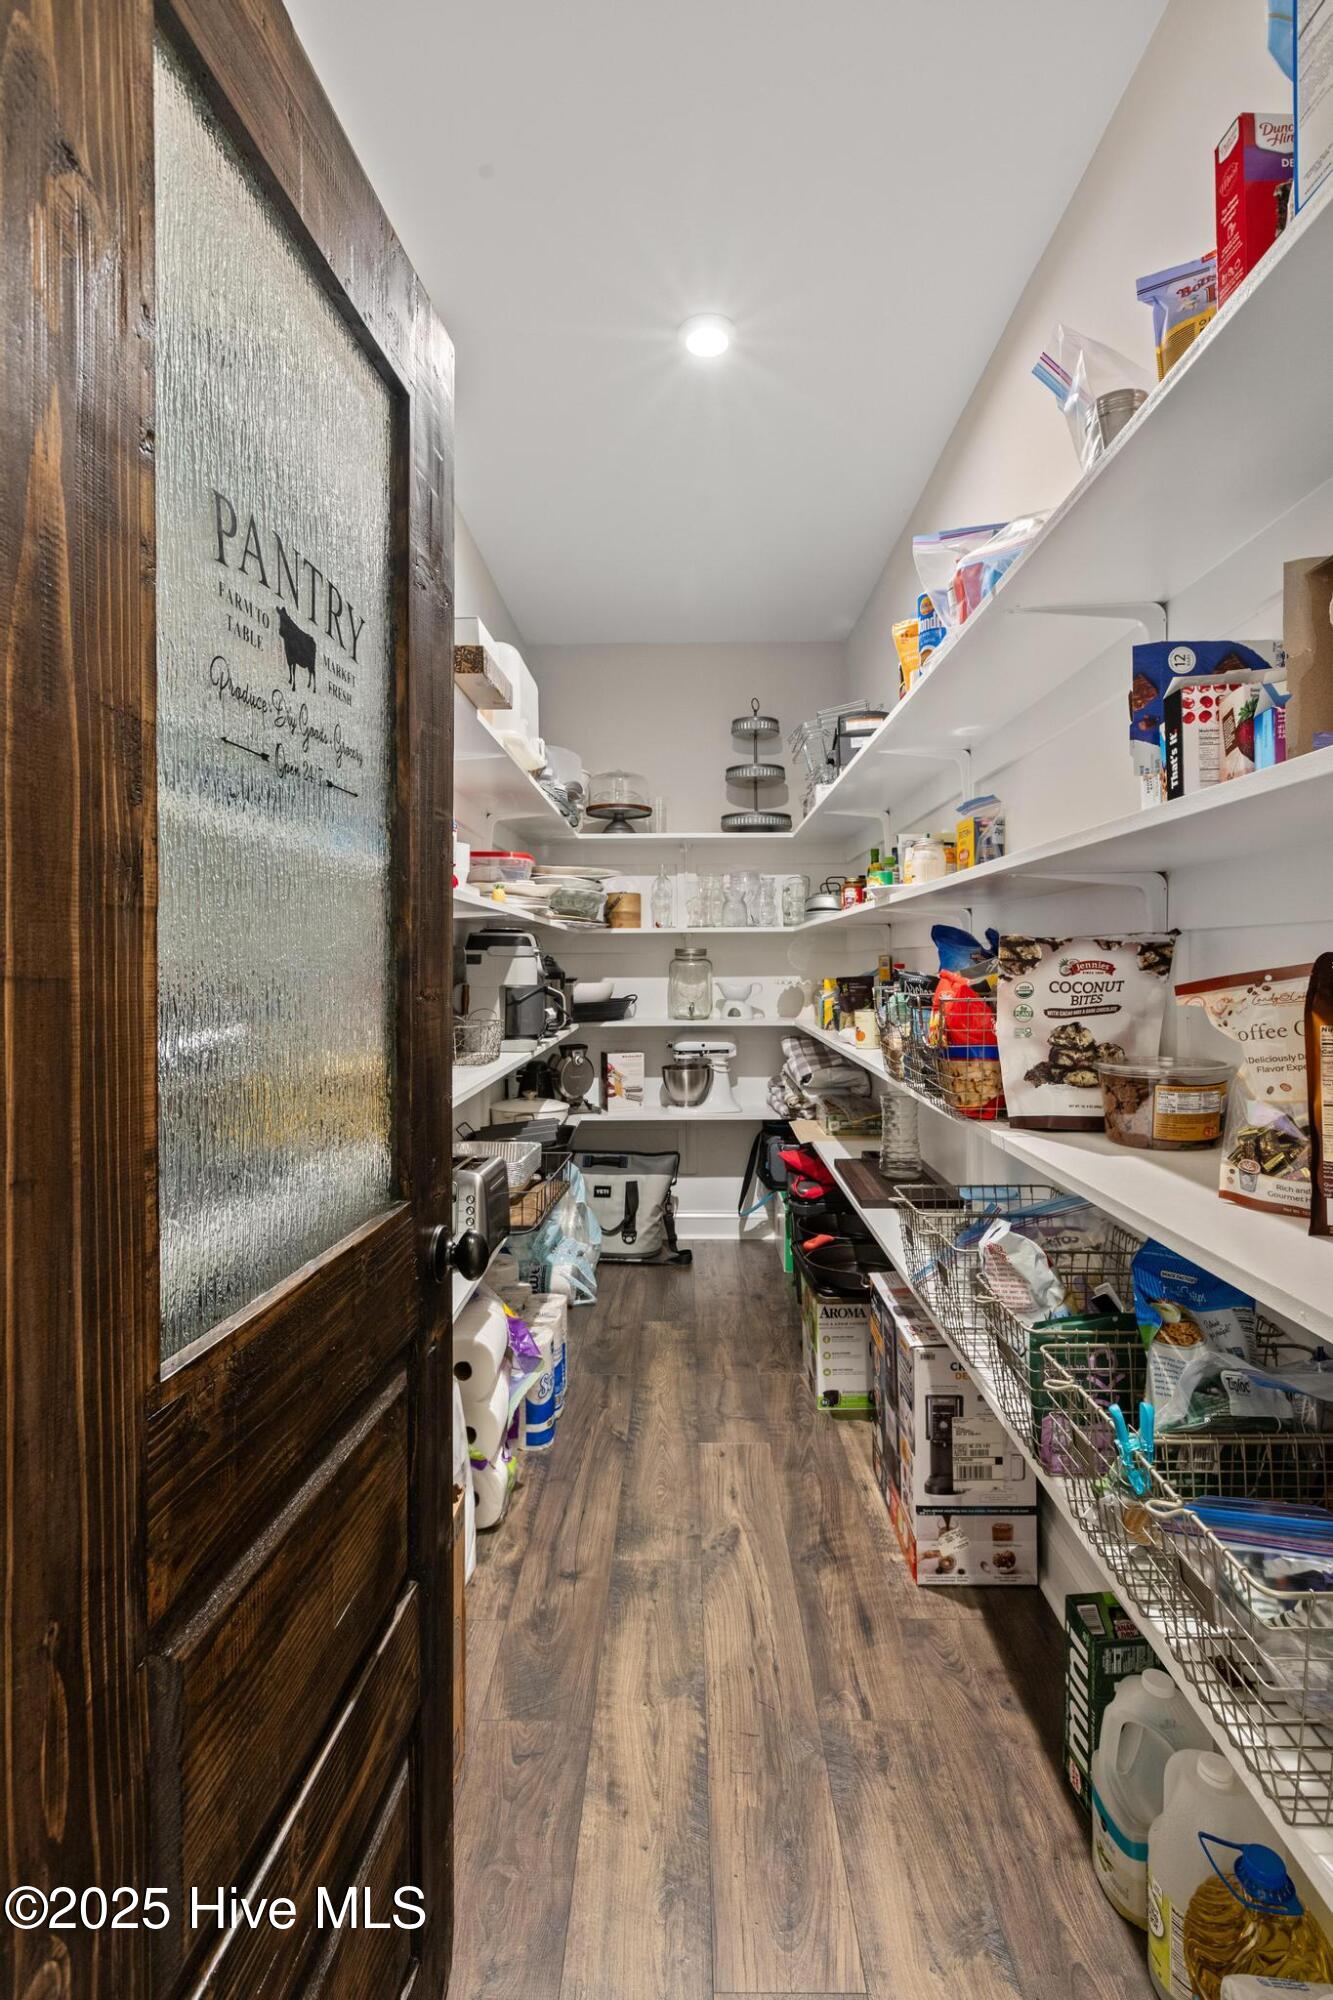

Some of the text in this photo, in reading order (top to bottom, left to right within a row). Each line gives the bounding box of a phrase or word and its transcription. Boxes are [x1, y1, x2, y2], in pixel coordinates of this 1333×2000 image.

[1259, 122, 1294, 136] Dunc
[1267, 132, 1294, 146] Hin
[210, 487, 366, 664] PANTRY
[218, 581, 270, 629] FARM TO
[225, 613, 264, 652] TABLE
[1173, 653, 1186, 668] 12
[323, 653, 356, 688] MARKET
[209, 655, 268, 713] Produce
[328, 680, 352, 707] FRESH
[1170, 748, 1179, 790] That's
[1049, 980, 1125, 994] COCONUT
[1070, 993, 1104, 1007] BITES
[1238, 1022, 1288, 1041] offee
[1248, 1054, 1296, 1065] Deliciously
[1256, 1065, 1284, 1073] Flavor
[1267, 1190, 1304, 1202] Gourmet
[820, 1305, 867, 1319] AROMA
